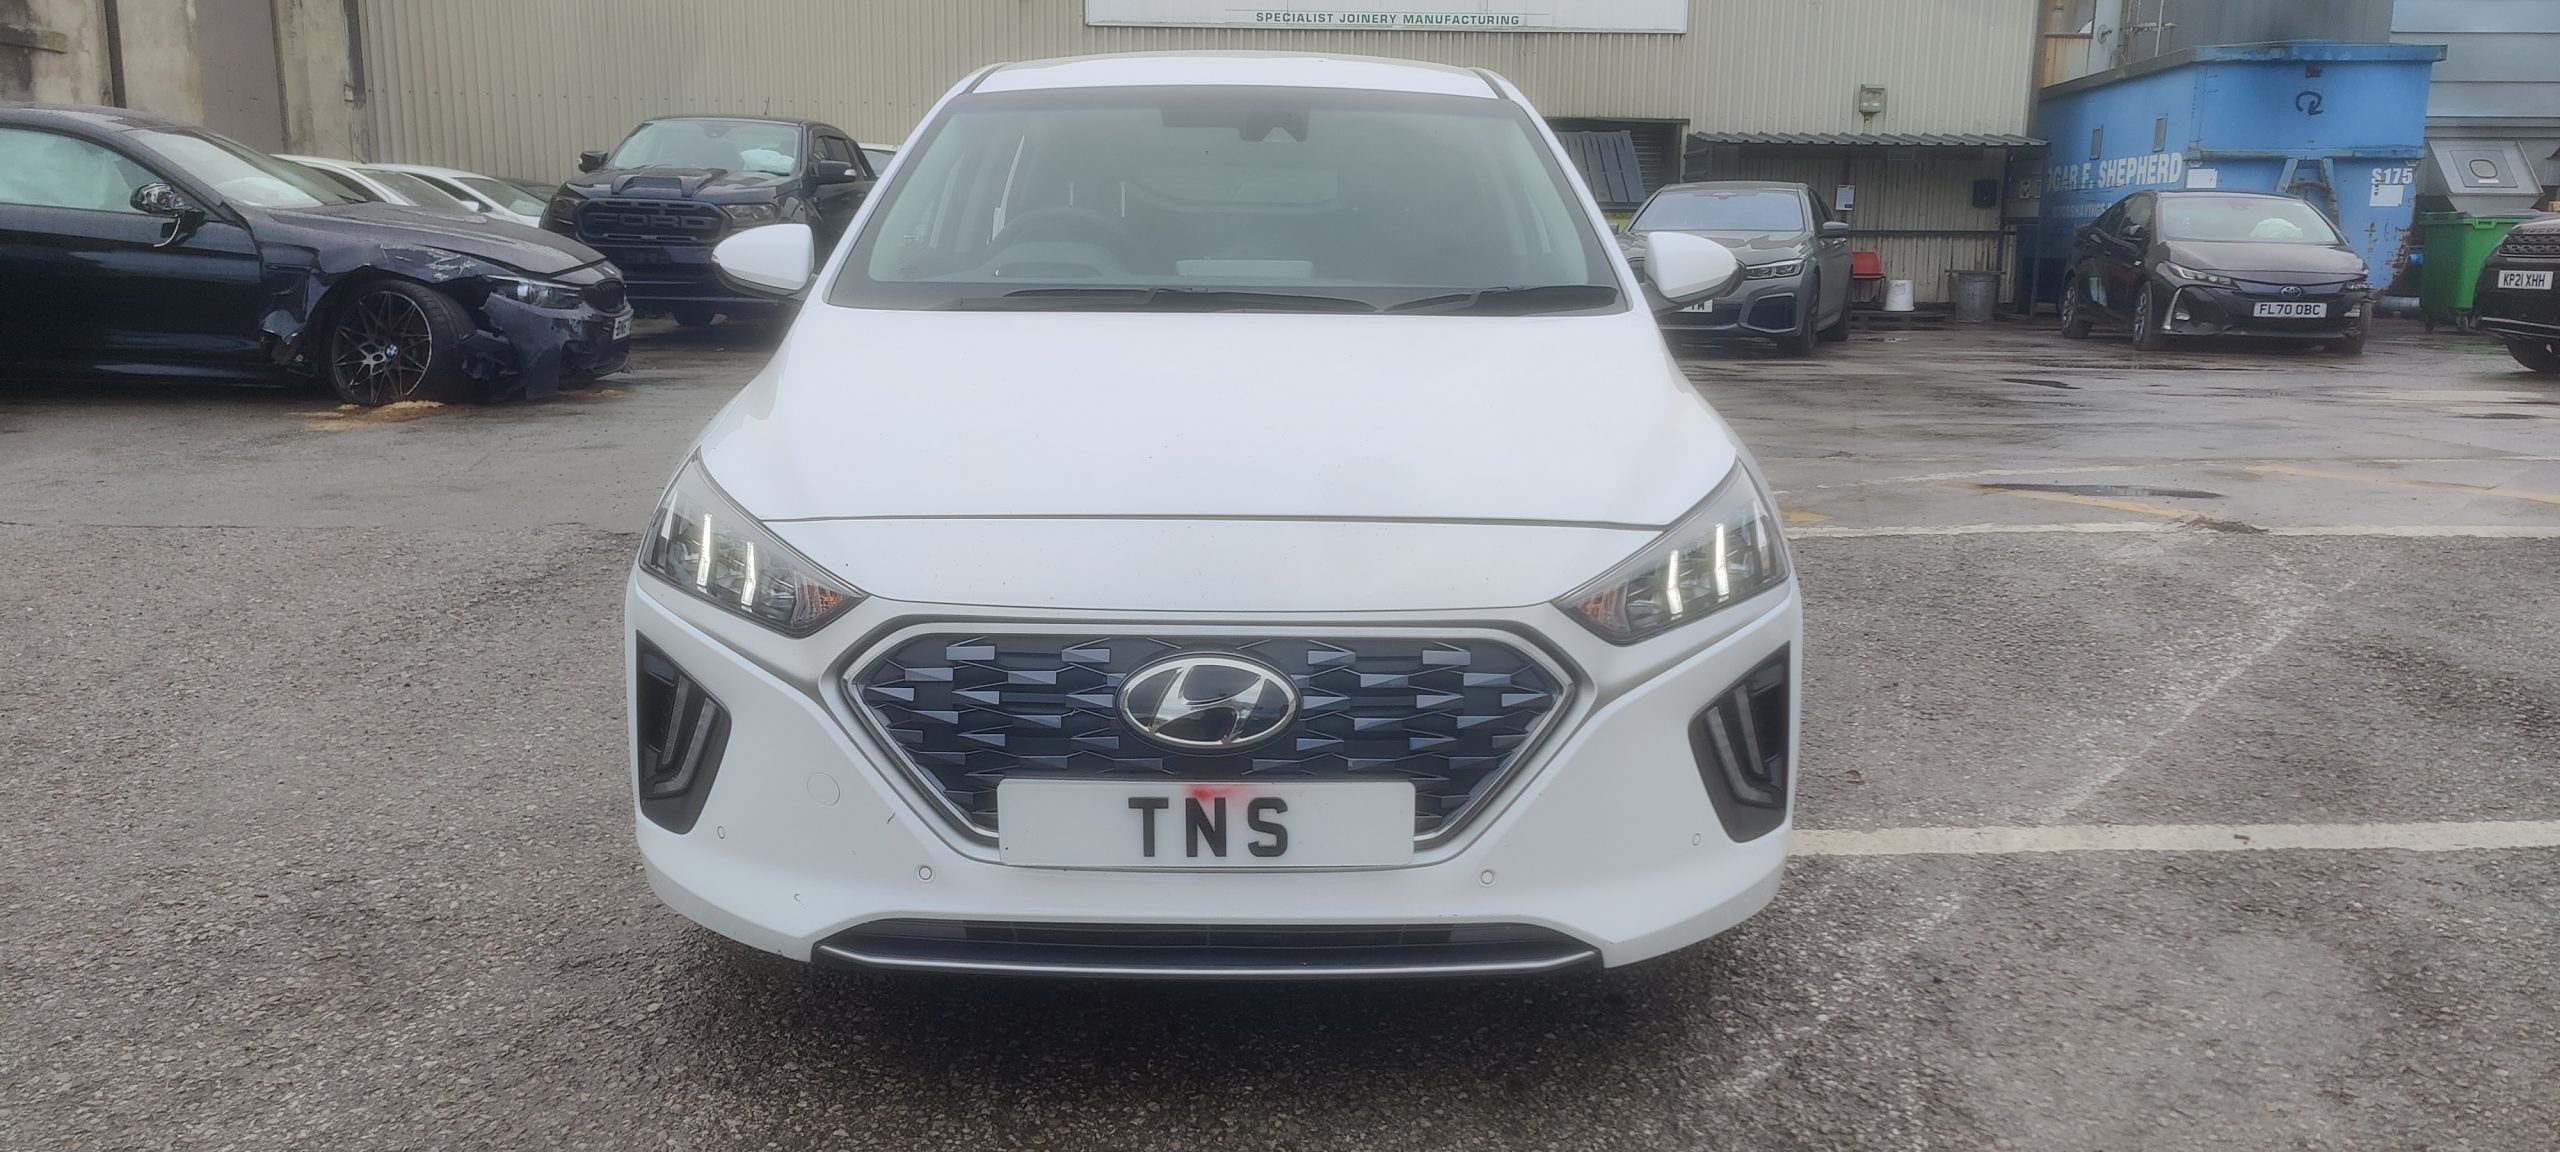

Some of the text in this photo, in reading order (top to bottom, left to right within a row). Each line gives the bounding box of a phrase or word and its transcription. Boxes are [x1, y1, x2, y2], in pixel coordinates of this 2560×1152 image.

[1256, 12, 1519, 26] SPECIALIST JOINERY MANUFACTURING
[2098, 152, 2183, 188] SHEPHERD
[2371, 167, 2413, 185] S175
[587, 212, 718, 229] FORD
[2503, 273, 2546, 287] KP21 XHH
[2259, 303, 2321, 315] FL70 OBC
[1128, 797, 1288, 857] TNS
